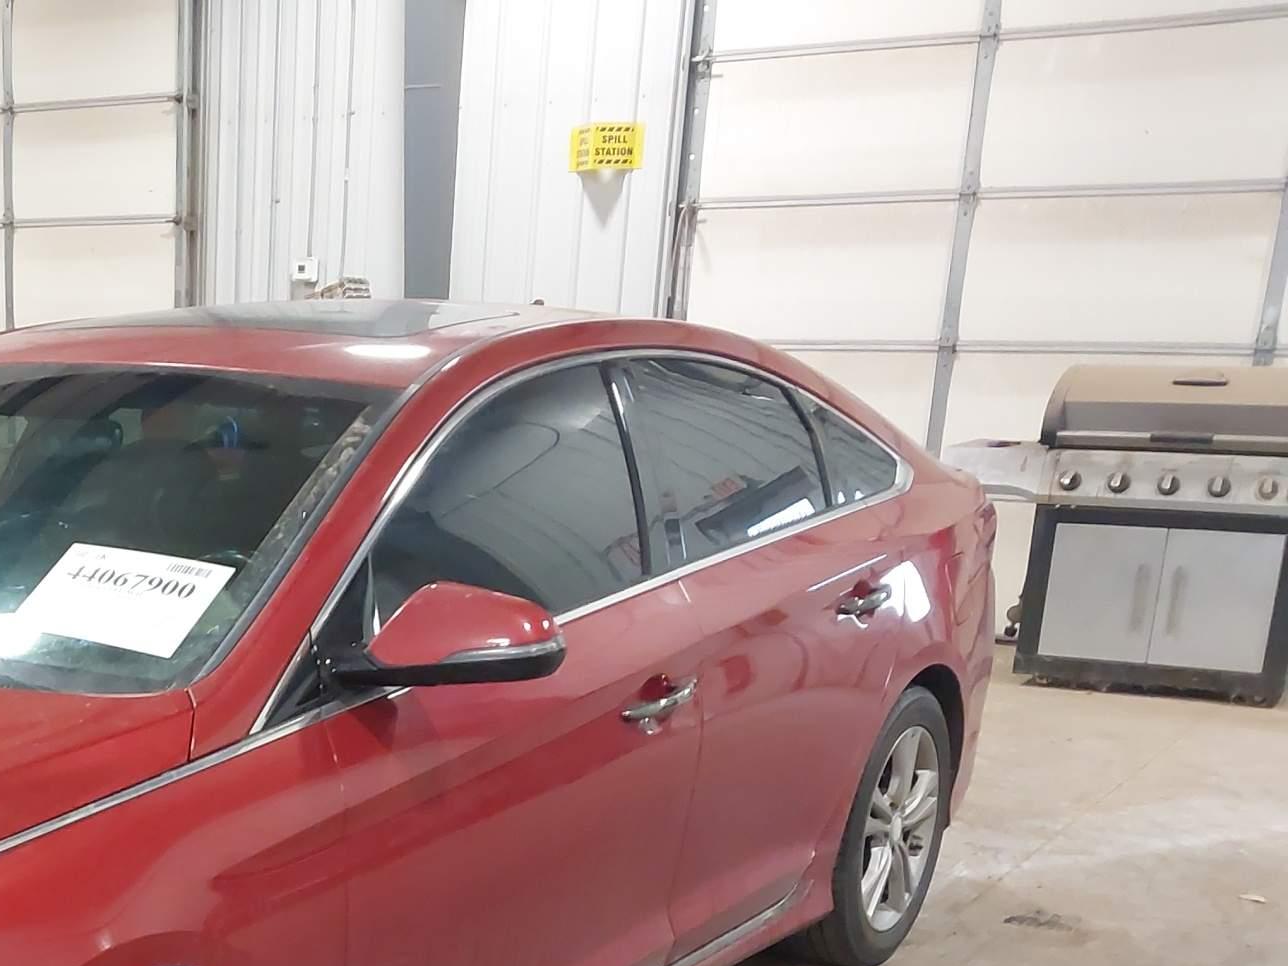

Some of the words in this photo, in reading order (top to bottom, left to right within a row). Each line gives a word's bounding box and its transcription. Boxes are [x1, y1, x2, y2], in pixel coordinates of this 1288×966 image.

[601, 134, 629, 144] SPILL
[594, 147, 633, 156] STATION
[66, 564, 197, 599] 44067900
